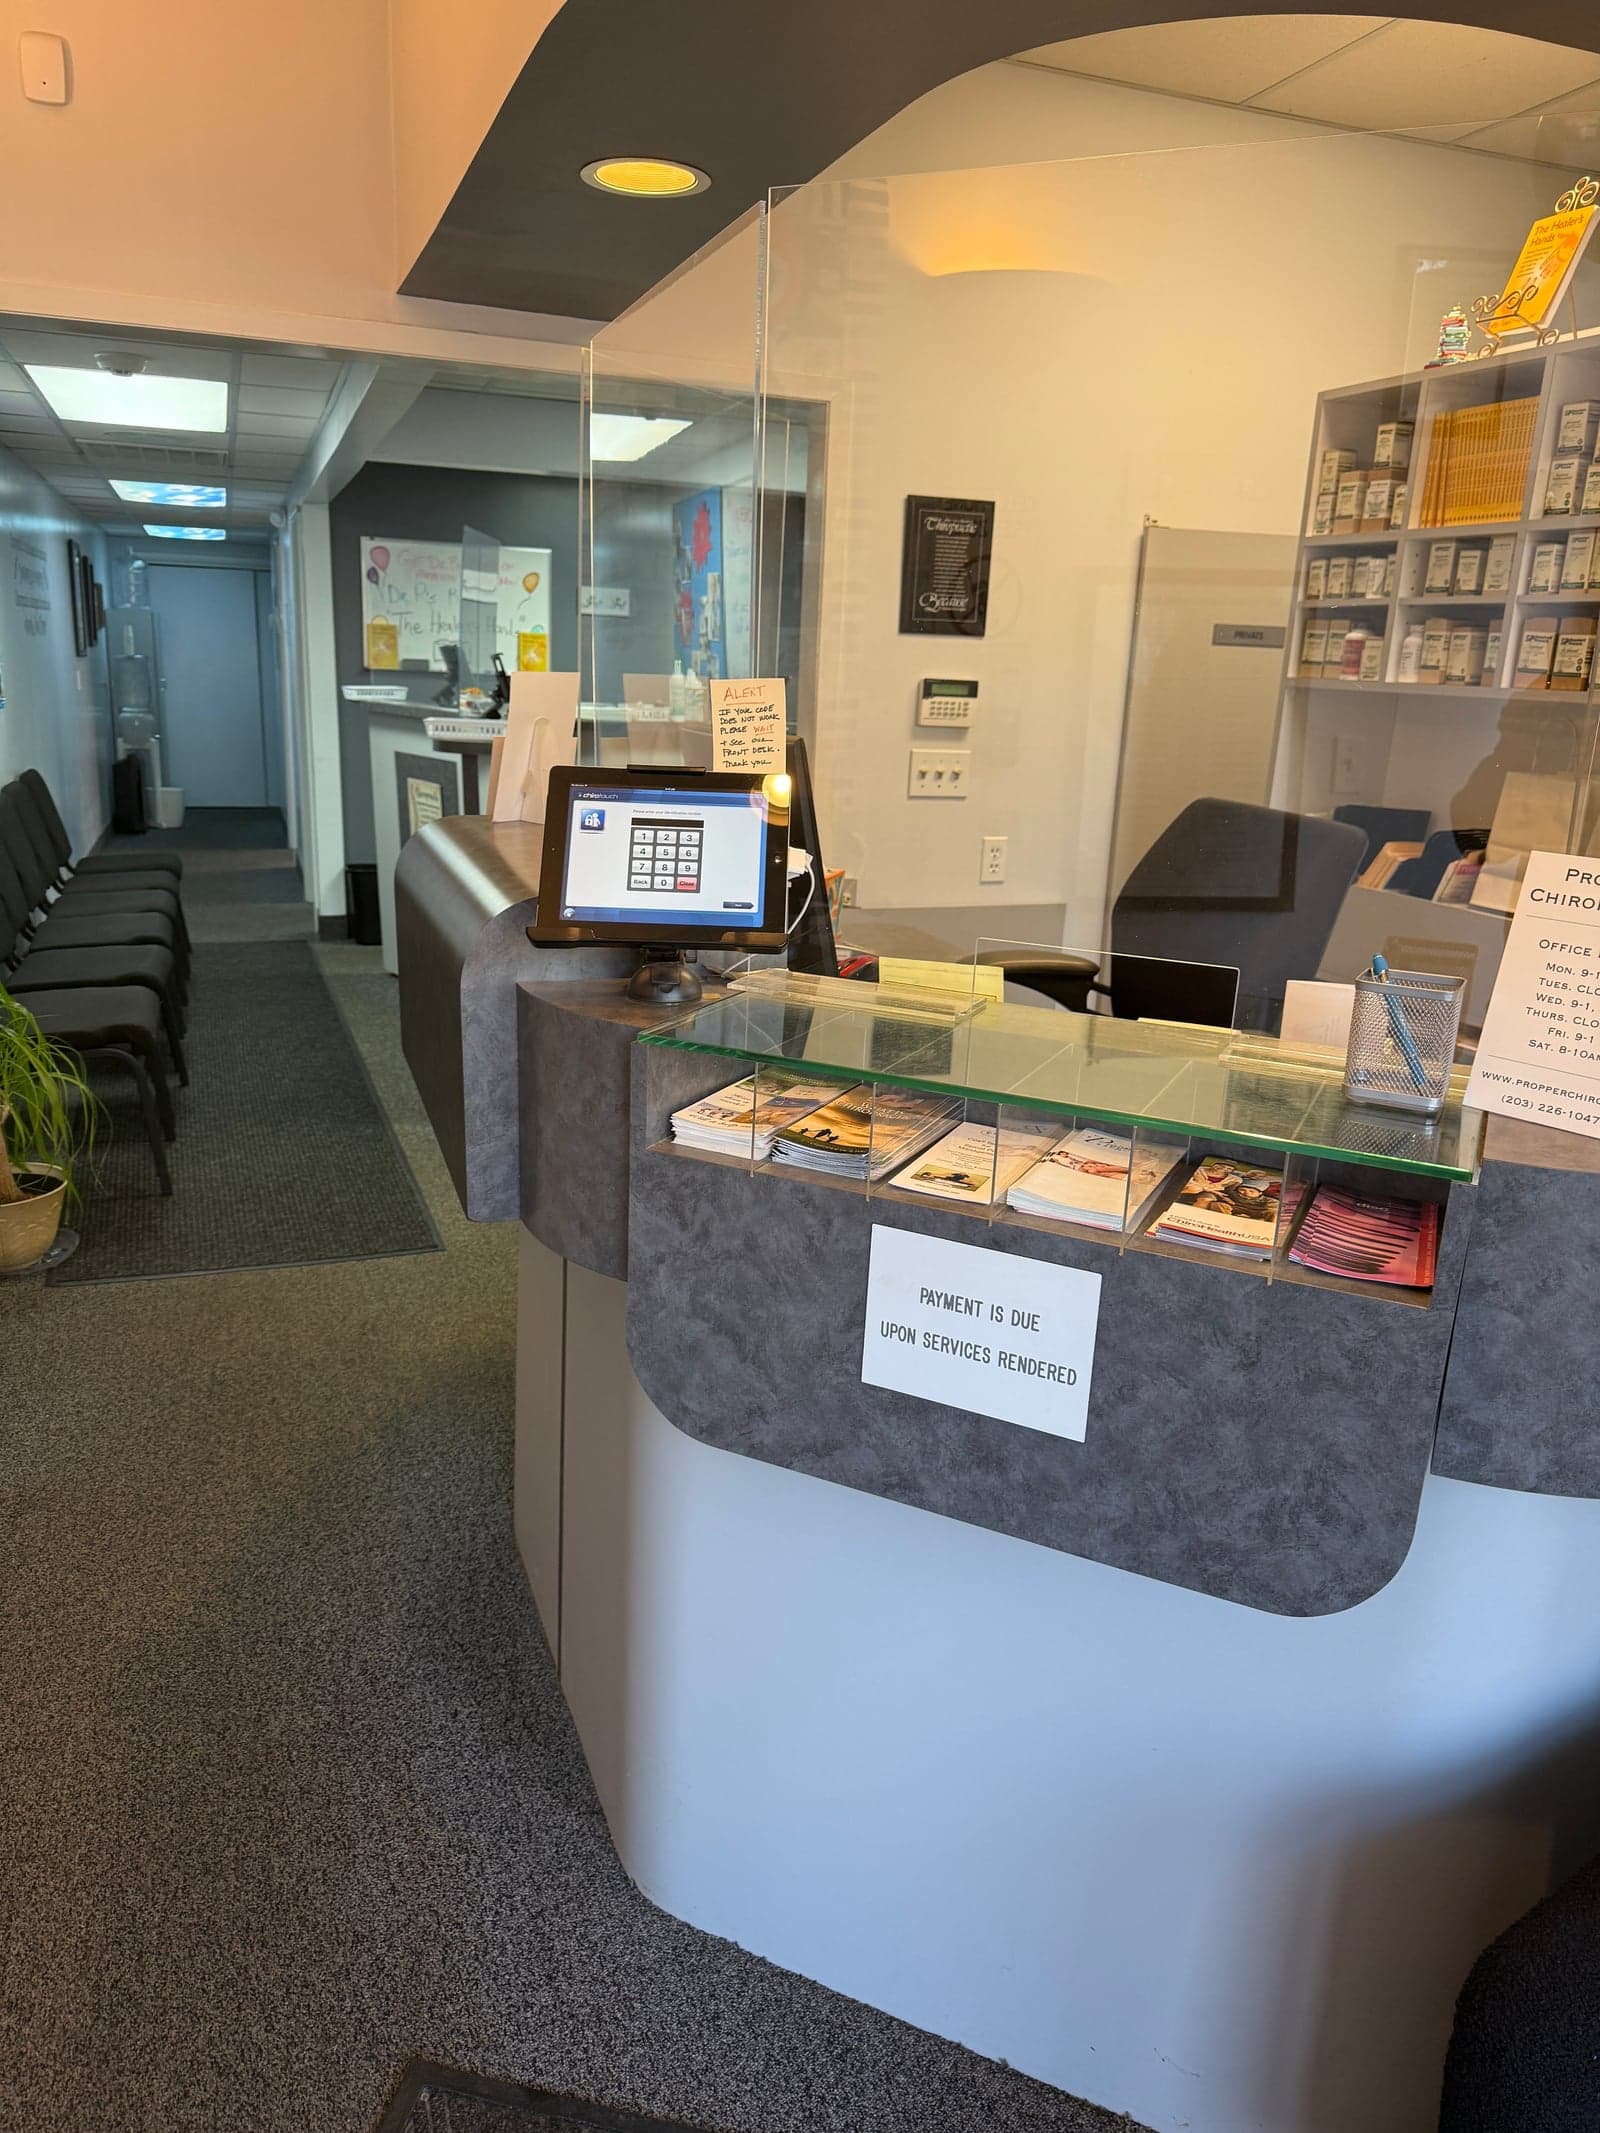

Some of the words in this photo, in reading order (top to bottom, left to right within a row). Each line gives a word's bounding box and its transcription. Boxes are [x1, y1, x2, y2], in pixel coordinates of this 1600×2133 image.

[724, 686, 766, 701] ALERT
[756, 704, 775, 714] CODE
[720, 717, 737, 725] DOES
[722, 748, 750, 757] FRONT
[1530, 888, 1600, 911] CHIRO
[1539, 939, 1593, 956] OFFICE
[1545, 963, 1576, 975] MON.
[1539, 977, 1572, 991] TUES.
[1536, 992, 1565, 1006] WED.
[1570, 1000, 1595, 1012] 9-1,
[1526, 1006, 1568, 1022] THURS.
[1573, 1016, 1600, 1029] CLO
[1547, 1027, 1570, 1039] FRI.
[1575, 1032, 1594, 1044] 9-1
[1528, 1039, 1554, 1052] SAT.
[1501, 1094, 1534, 1110] (203)
[1537, 1103, 1600, 1125] 226-1047
[920, 1287, 983, 1318] PAYMENT
[990, 1304, 1004, 1323] IS
[1011, 1309, 1041, 1332] DUE
[880, 1320, 917, 1345] UPON
[923, 1332, 991, 1364] SERVICES
[998, 1350, 1078, 1386] RENDERED
